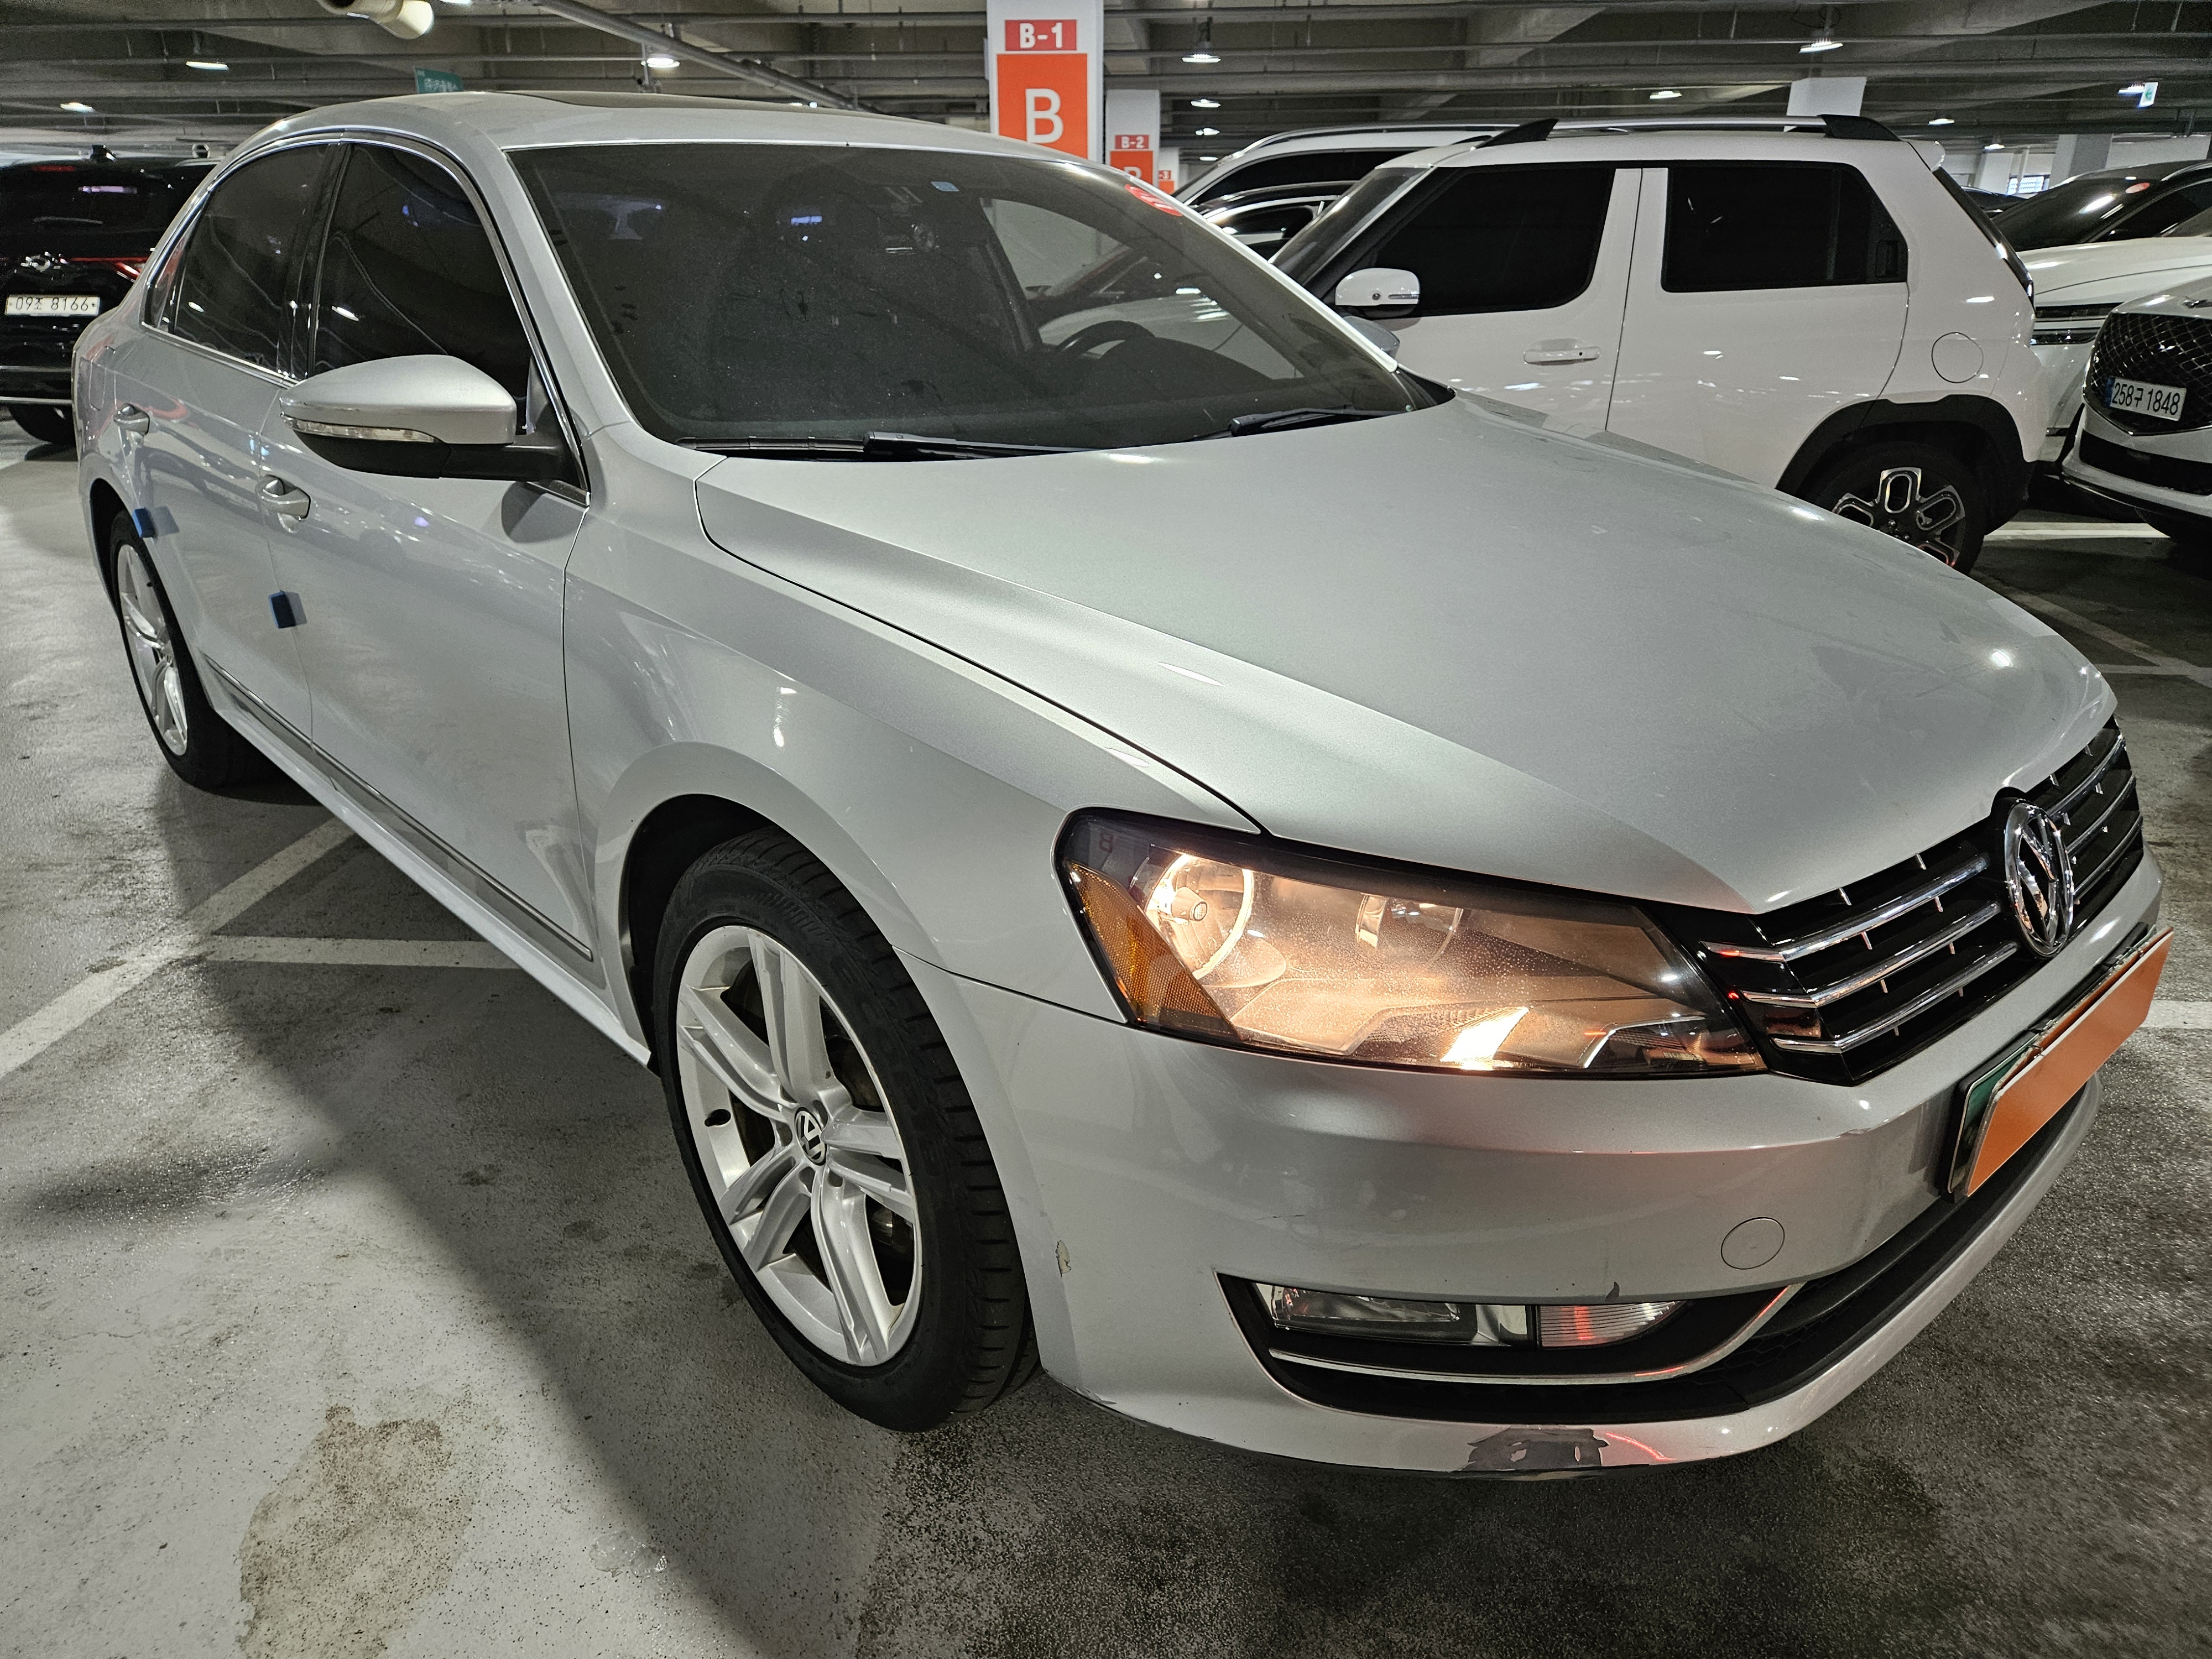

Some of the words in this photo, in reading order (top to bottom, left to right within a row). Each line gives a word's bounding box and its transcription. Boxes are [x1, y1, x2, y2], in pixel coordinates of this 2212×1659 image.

[1019, 22, 1063, 49] B-1
[1025, 88, 1064, 144] B
[1121, 136, 1145, 149] B-2
[1158, 170, 1170, 180] -3
[51, 297, 88, 311] 8166
[2111, 382, 2144, 408] 258구
[2147, 388, 2180, 416] 1848
